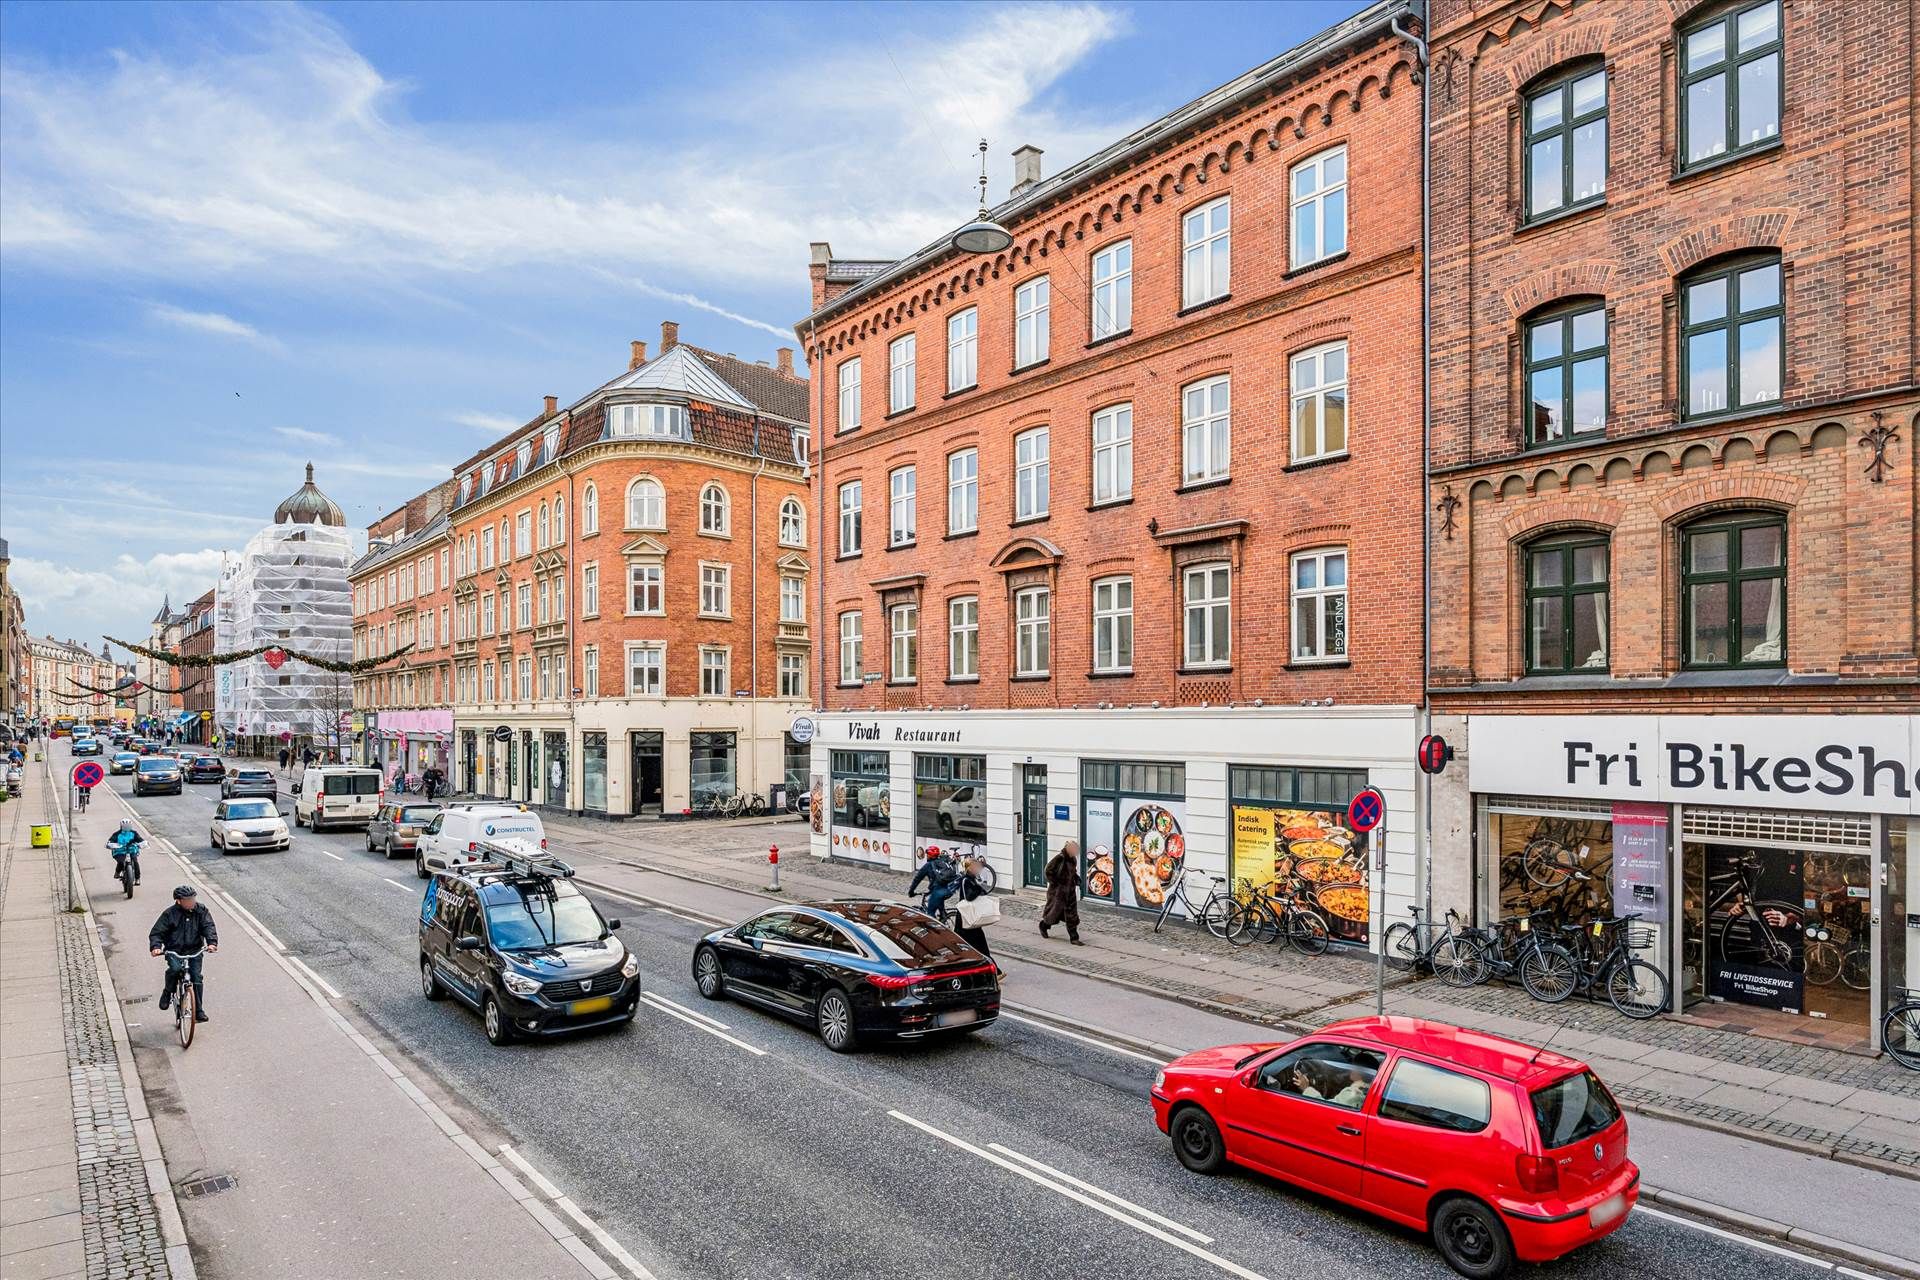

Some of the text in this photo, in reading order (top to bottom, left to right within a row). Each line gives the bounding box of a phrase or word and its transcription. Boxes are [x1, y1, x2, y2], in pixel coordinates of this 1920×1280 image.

[1335, 597, 1344, 652] TANDLÆGE
[848, 722, 961, 743] Vivah Restaurant
[1563, 741, 1920, 798] Fri BikeSh
[1237, 815, 1260, 824] Indisk
[496, 826, 536, 834] CONSTRUCTEL
[1237, 825, 1268, 836] Catering
[1620, 857, 1628, 867] 2
[1620, 879, 1628, 889] 3
[1720, 970, 1795, 989] FRI LIVSTIDSSERVICE
[1734, 982, 1745, 990] Fri
[1745, 983, 1779, 996] BikeShop
